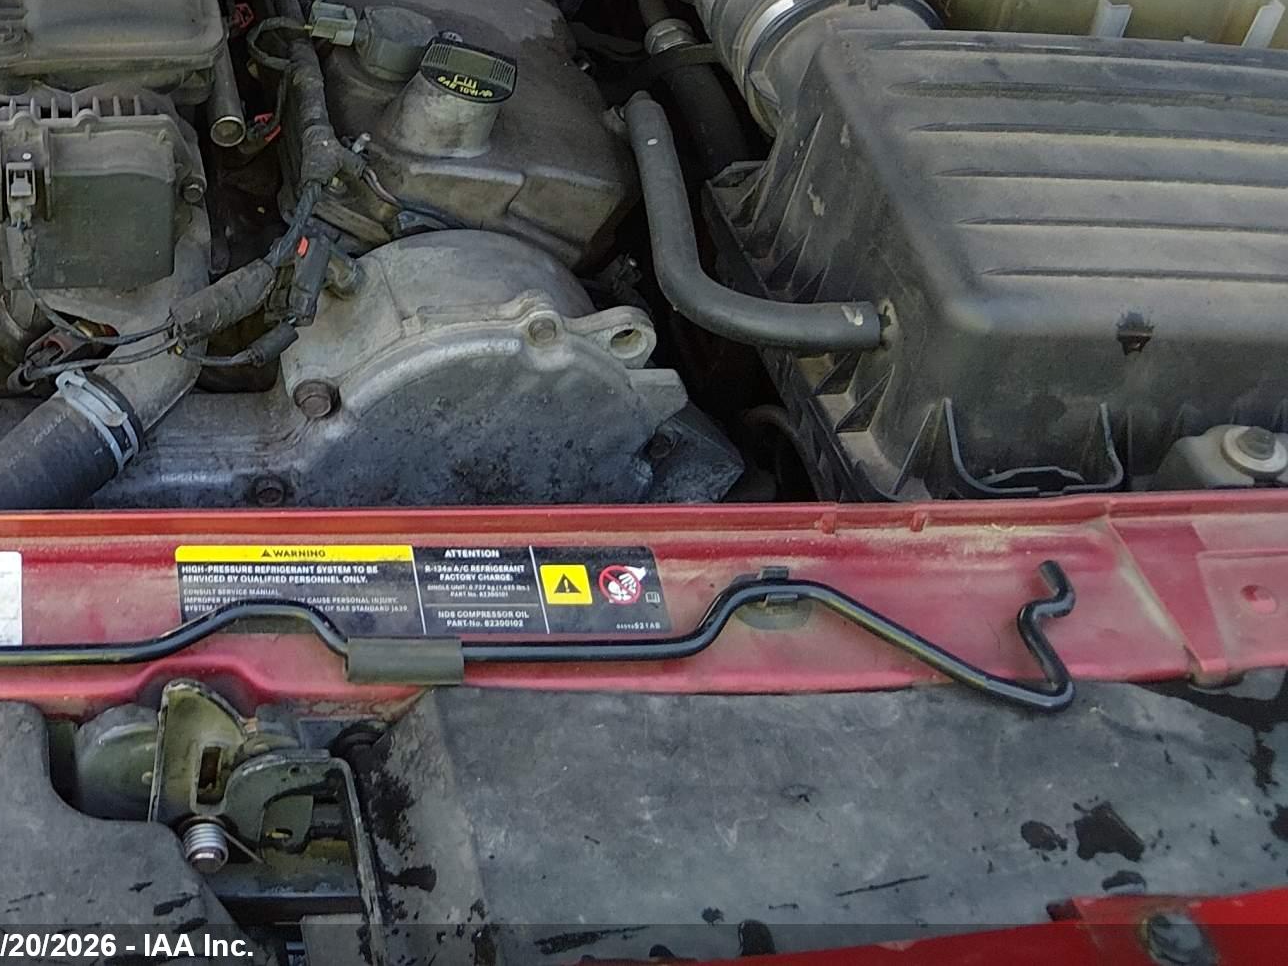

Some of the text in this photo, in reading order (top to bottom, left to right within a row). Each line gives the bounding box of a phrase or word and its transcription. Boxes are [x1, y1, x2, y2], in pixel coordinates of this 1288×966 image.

[273, 549, 326, 558] WARNING
[444, 549, 500, 558] ATTENTION
[181, 565, 378, 574] HIGH-PRESSURE REFRIGERANT SYSTEM TO BE
[453, 564, 469, 573] A/C
[470, 564, 525, 573] REFRIGERANT
[182, 575, 368, 584] SERVICED BY QUALIFIED PERSONNEL ONLY.
[439, 573, 476, 581] FACTORY
[183, 588, 216, 596] CONSULT
[218, 588, 247, 596] SERVICE
[184, 596, 220, 604] IMPROPER
[307, 596, 330, 604] CAUSE
[332, 596, 369, 604] PERSONAL
[456, 610, 513, 619] COMPRESSOR
[515, 610, 530, 619] OIL
[446, 619, 467, 627] PART
